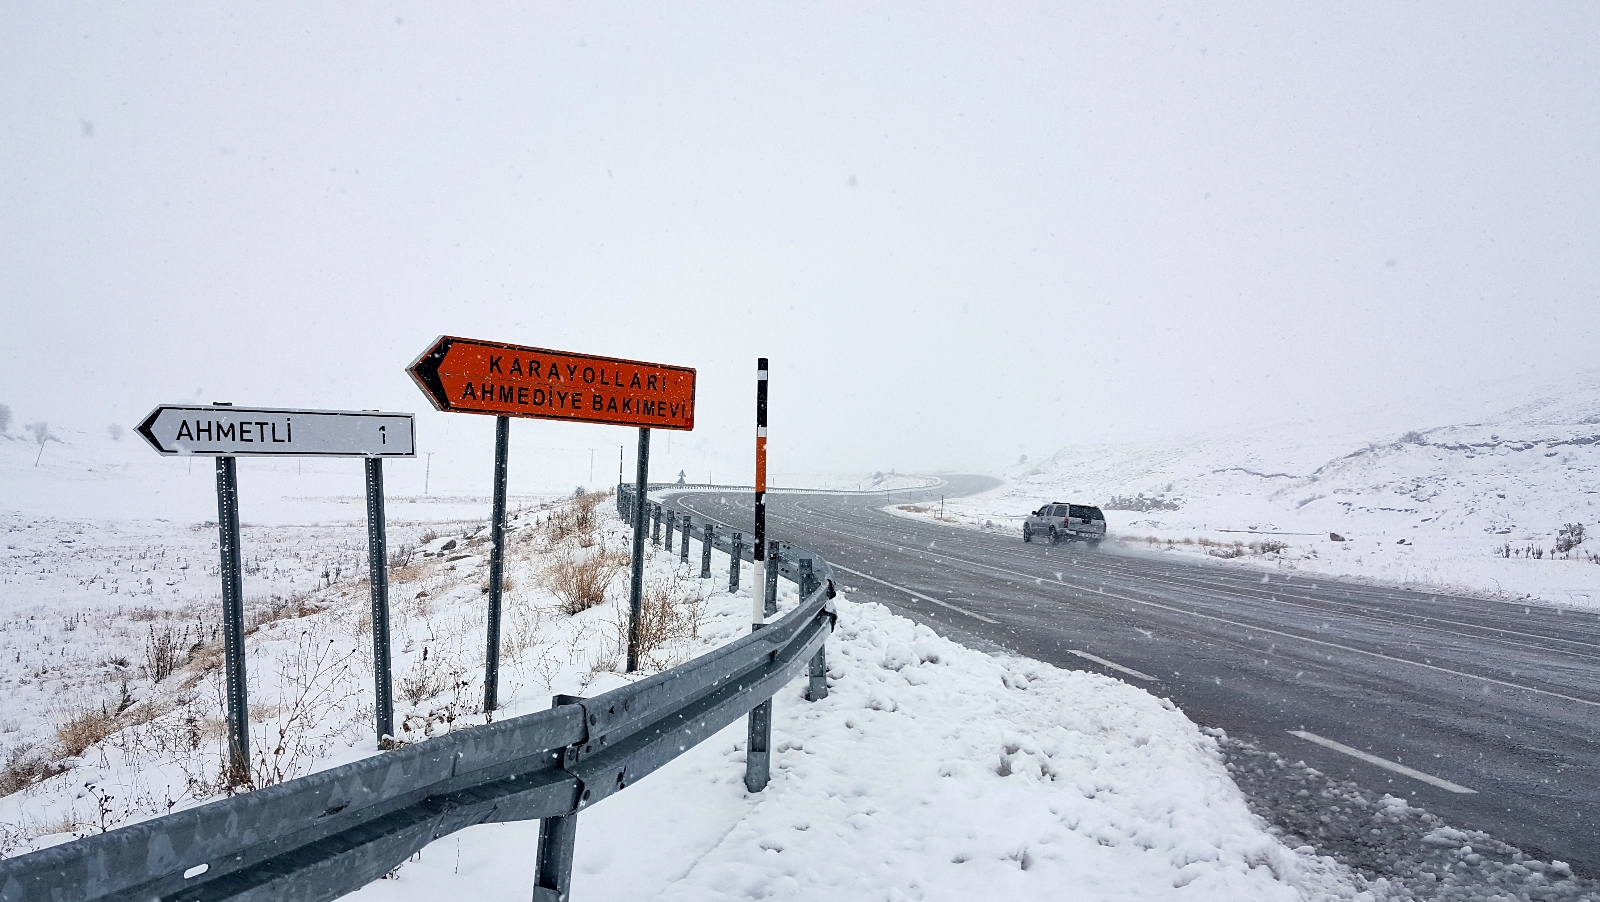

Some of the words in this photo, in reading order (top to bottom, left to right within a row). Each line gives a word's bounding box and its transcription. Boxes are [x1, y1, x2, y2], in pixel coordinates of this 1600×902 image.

[489, 355, 667, 392] KARAYOLLARI
[462, 381, 583, 410] AHMEDİYE
[592, 394, 686, 419] BAKIMEVİ
[176, 417, 292, 443] AHMETLİ
[378, 425, 387, 444] 1
